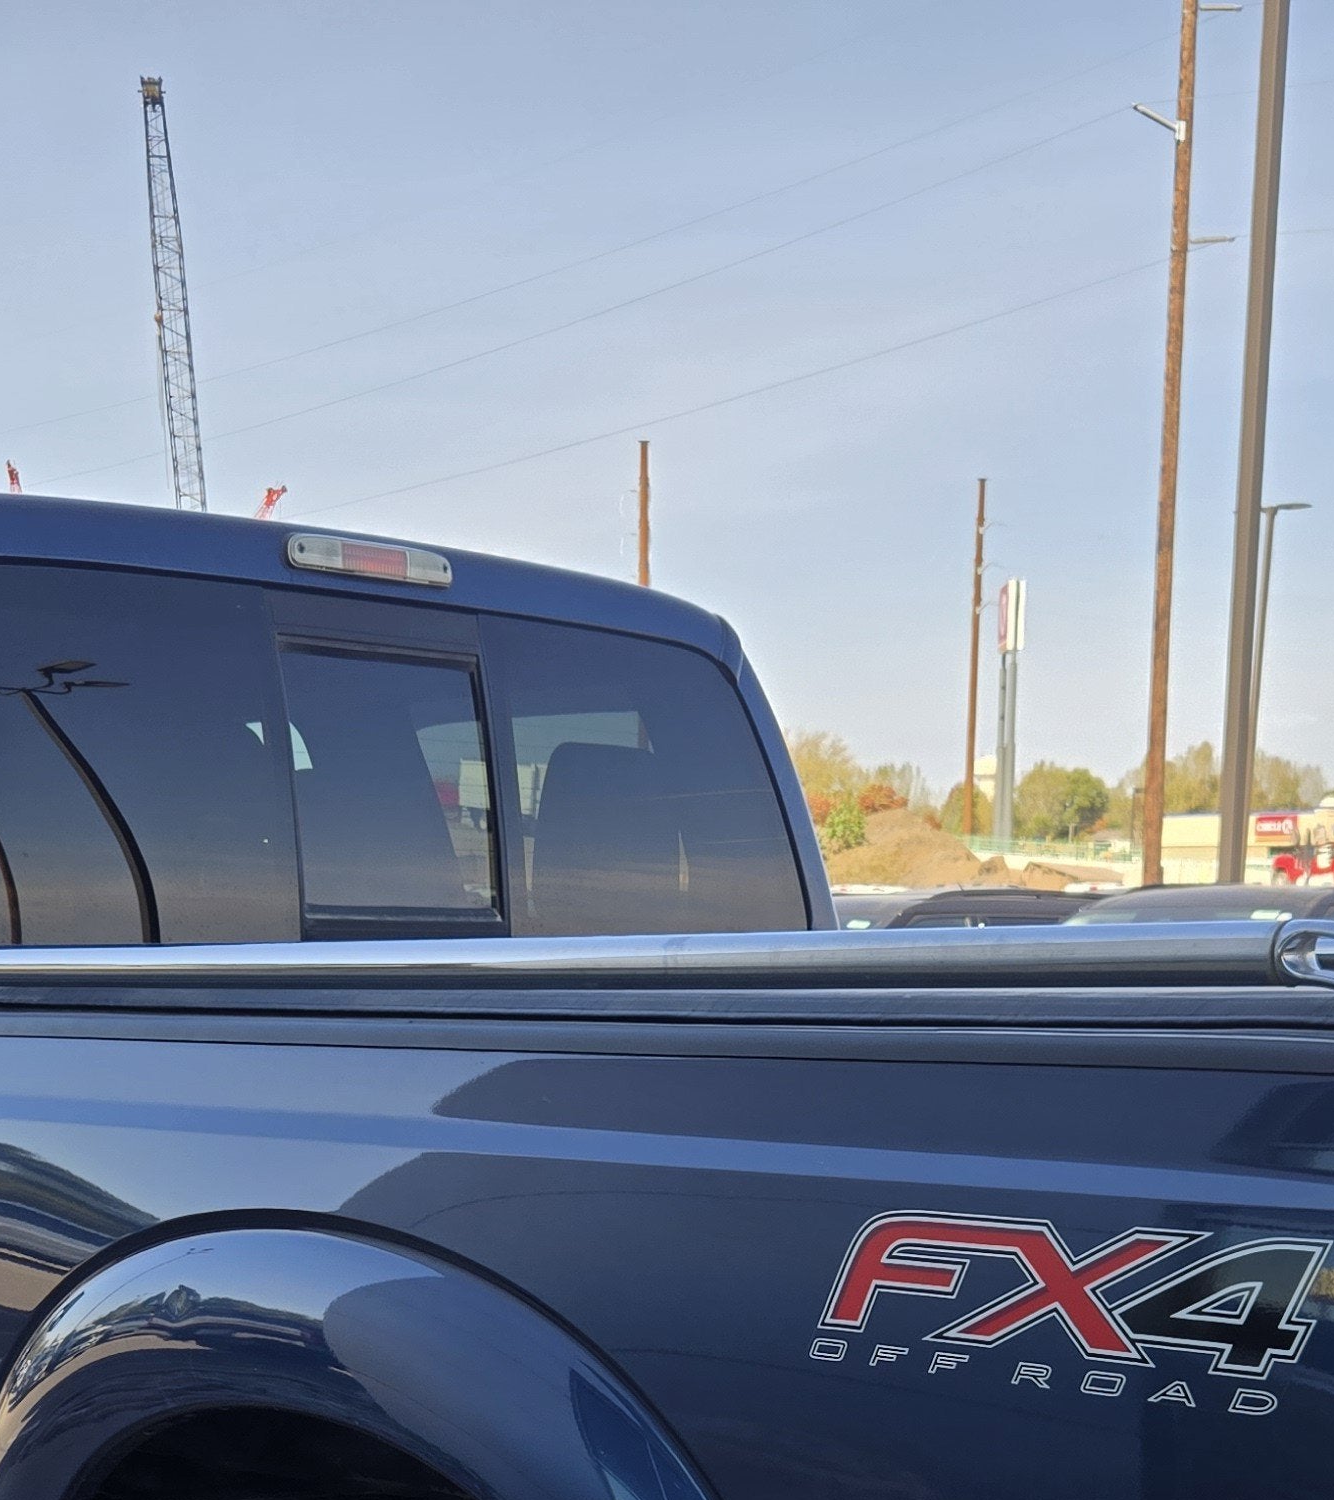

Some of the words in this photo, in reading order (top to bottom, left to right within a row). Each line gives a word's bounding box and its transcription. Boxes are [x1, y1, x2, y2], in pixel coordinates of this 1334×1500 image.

[817, 1209, 1334, 1380] FX4
[808, 1338, 970, 1375] OFF
[1010, 1361, 1279, 1416] ROAD
